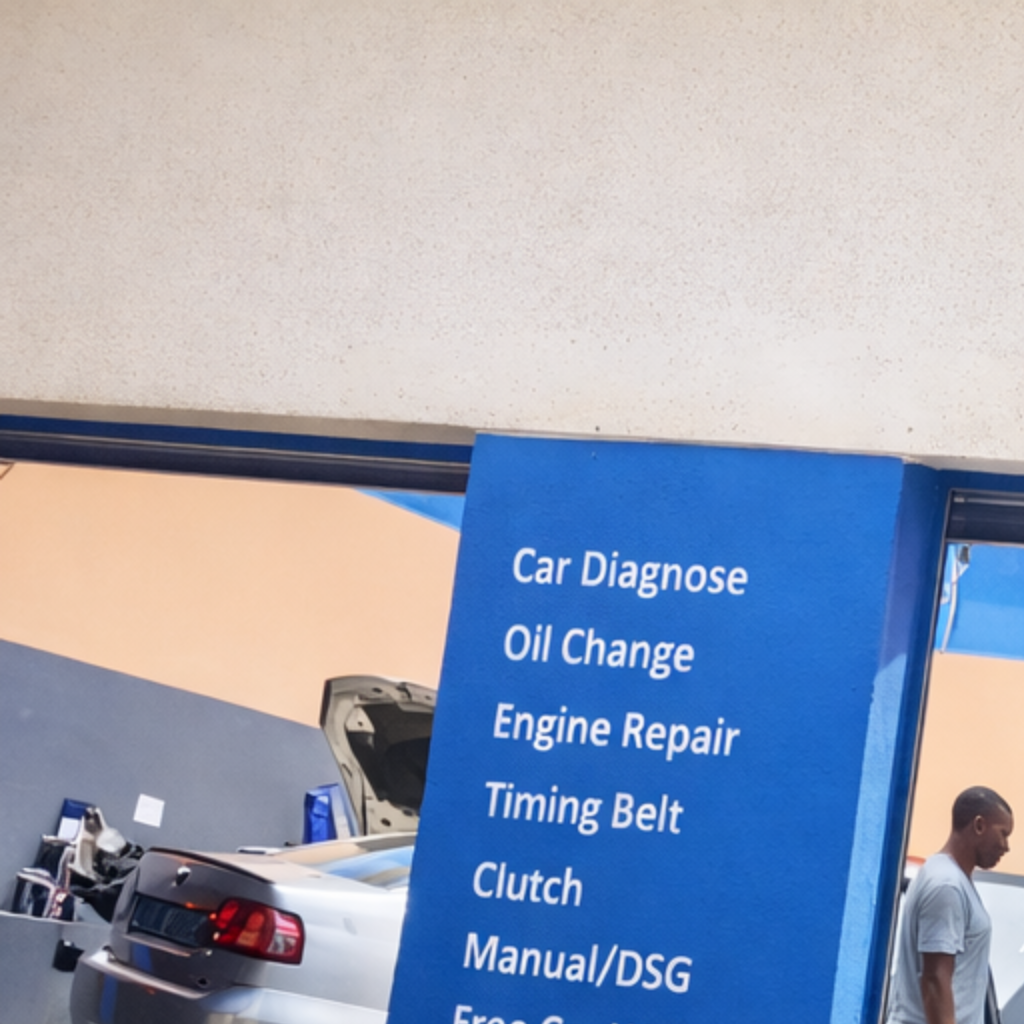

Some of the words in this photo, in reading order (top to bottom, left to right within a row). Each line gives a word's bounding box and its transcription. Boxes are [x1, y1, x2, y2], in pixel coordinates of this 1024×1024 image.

[513, 547, 572, 585] Car
[581, 550, 749, 600] Diagnose
[504, 624, 553, 663] Oil
[561, 627, 695, 680] Change
[493, 702, 611, 752] Engine
[621, 712, 741, 761] Repair
[485, 781, 603, 836] Timing
[611, 792, 684, 835] Belt
[473, 861, 583, 907] Clutch
[463, 932, 693, 993] Manual/DSG
